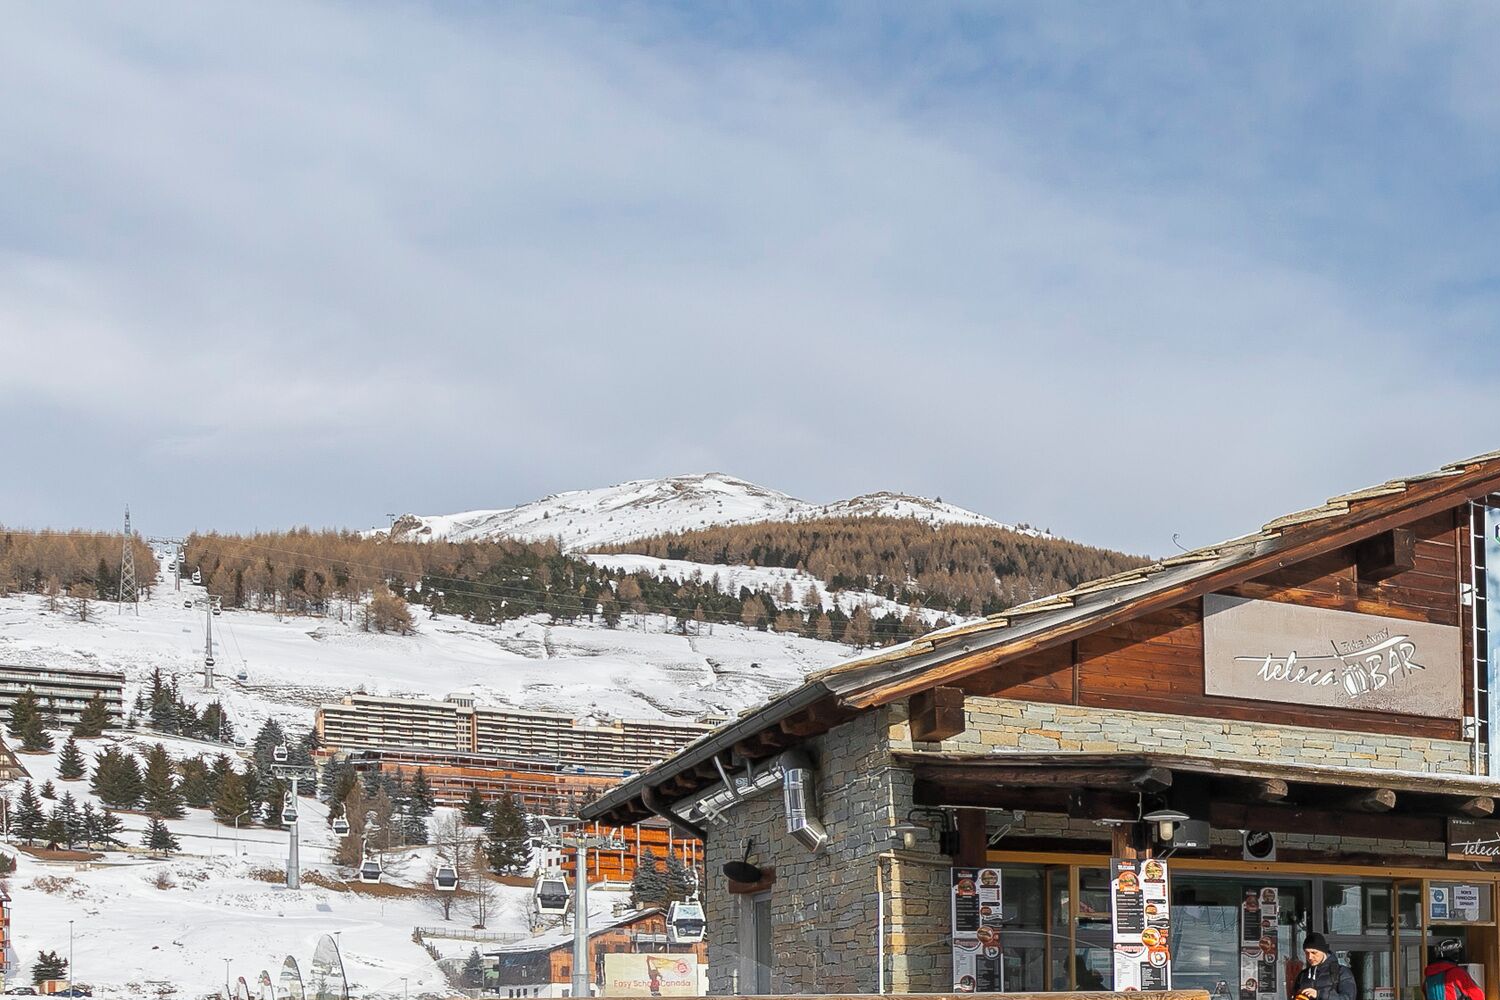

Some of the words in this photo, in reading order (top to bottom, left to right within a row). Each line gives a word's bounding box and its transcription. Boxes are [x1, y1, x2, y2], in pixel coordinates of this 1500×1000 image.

[1365, 641, 1425, 691] BAR
[614, 980, 632, 989] Easy
[660, 979, 691, 988] Canada
